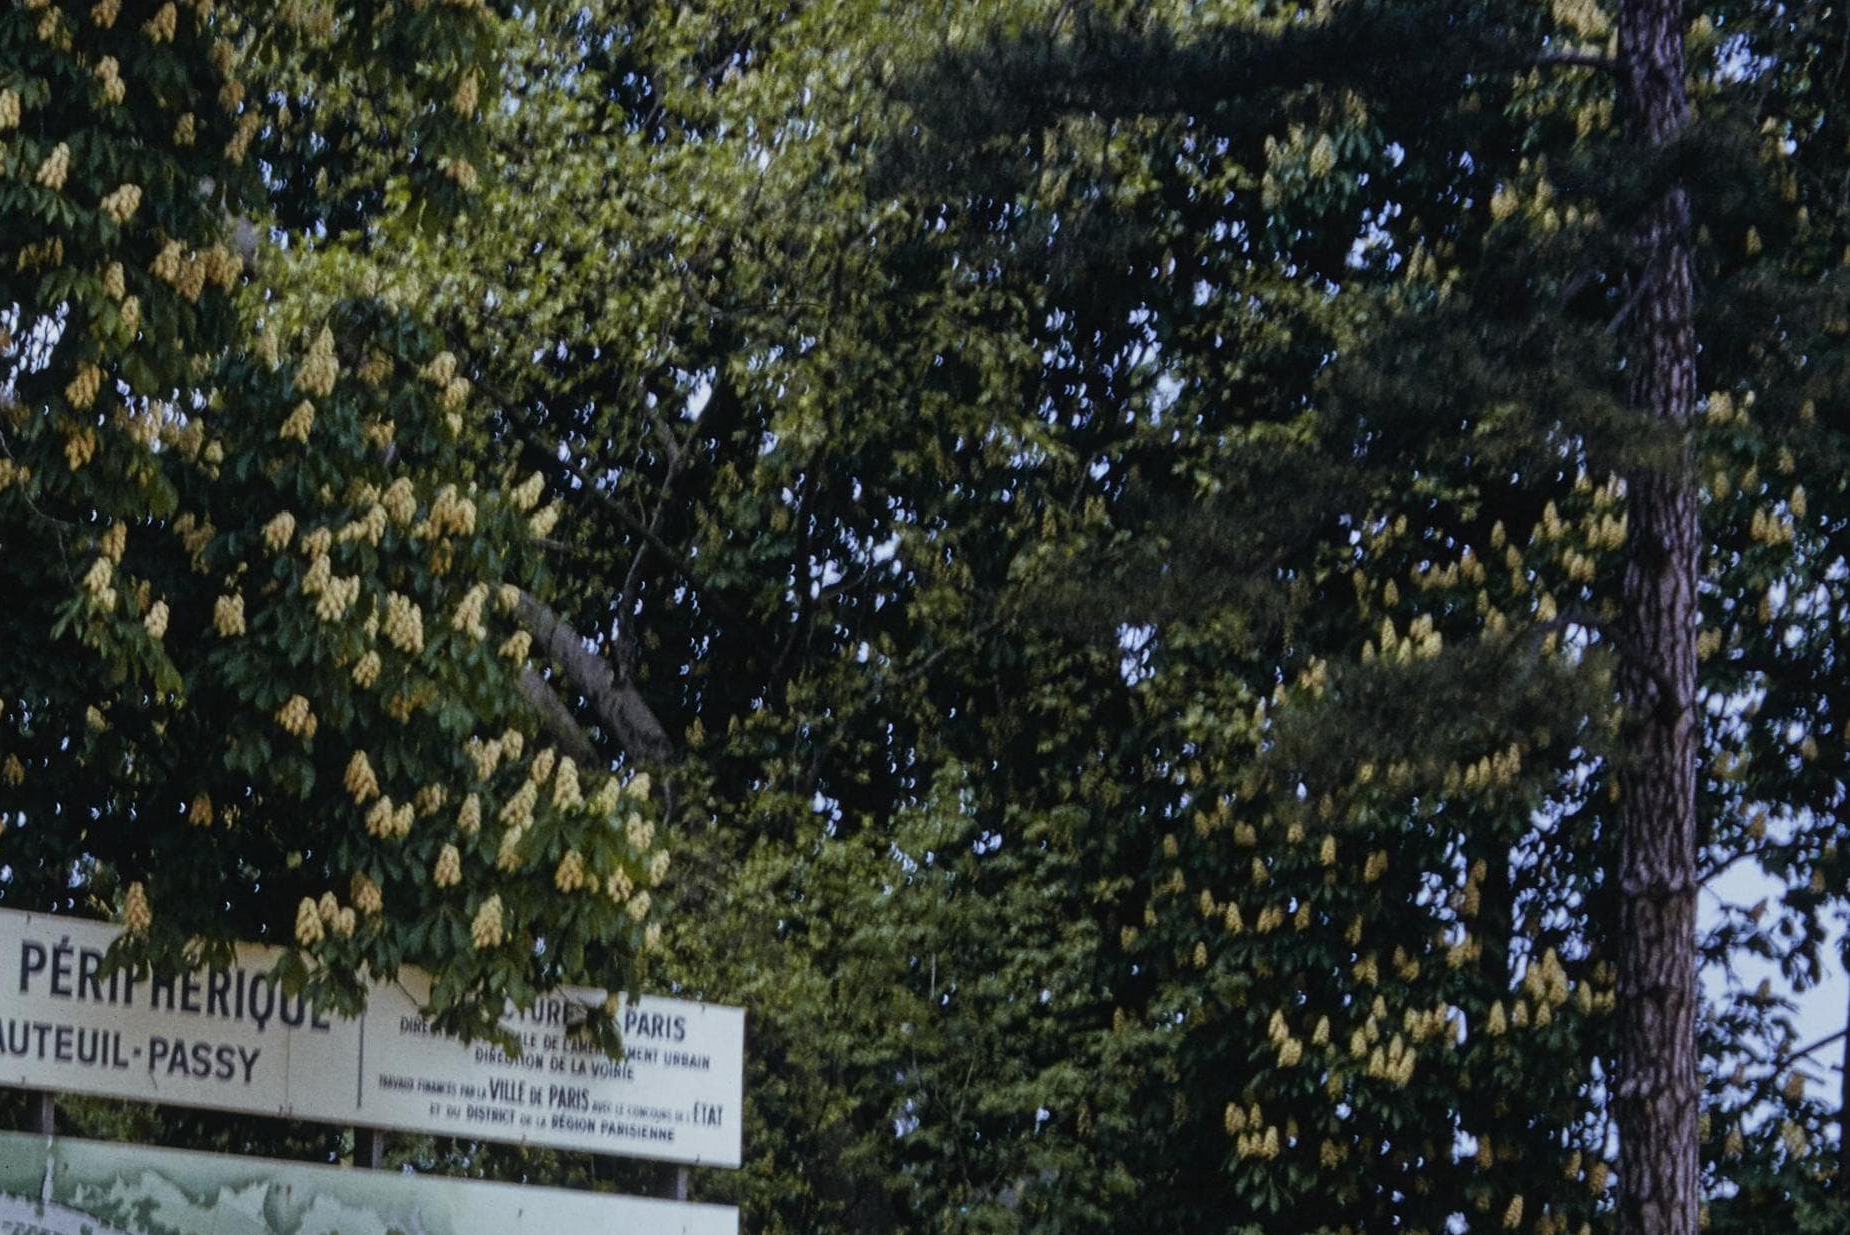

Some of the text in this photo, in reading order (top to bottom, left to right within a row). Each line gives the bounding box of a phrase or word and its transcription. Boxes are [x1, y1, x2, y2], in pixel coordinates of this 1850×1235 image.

[624, 1009, 686, 1042] PARIS
[551, 1056, 565, 1074] DE
[570, 1058, 588, 1076] LA
[664, 1051, 711, 1072] URBAIN
[489, 1075, 526, 1104] VILLE
[530, 1086, 543, 1106] DE
[549, 1084, 590, 1113] PARIS
[466, 1103, 516, 1124] DISTRICT
[600, 1121, 676, 1142] PARISIENNE
